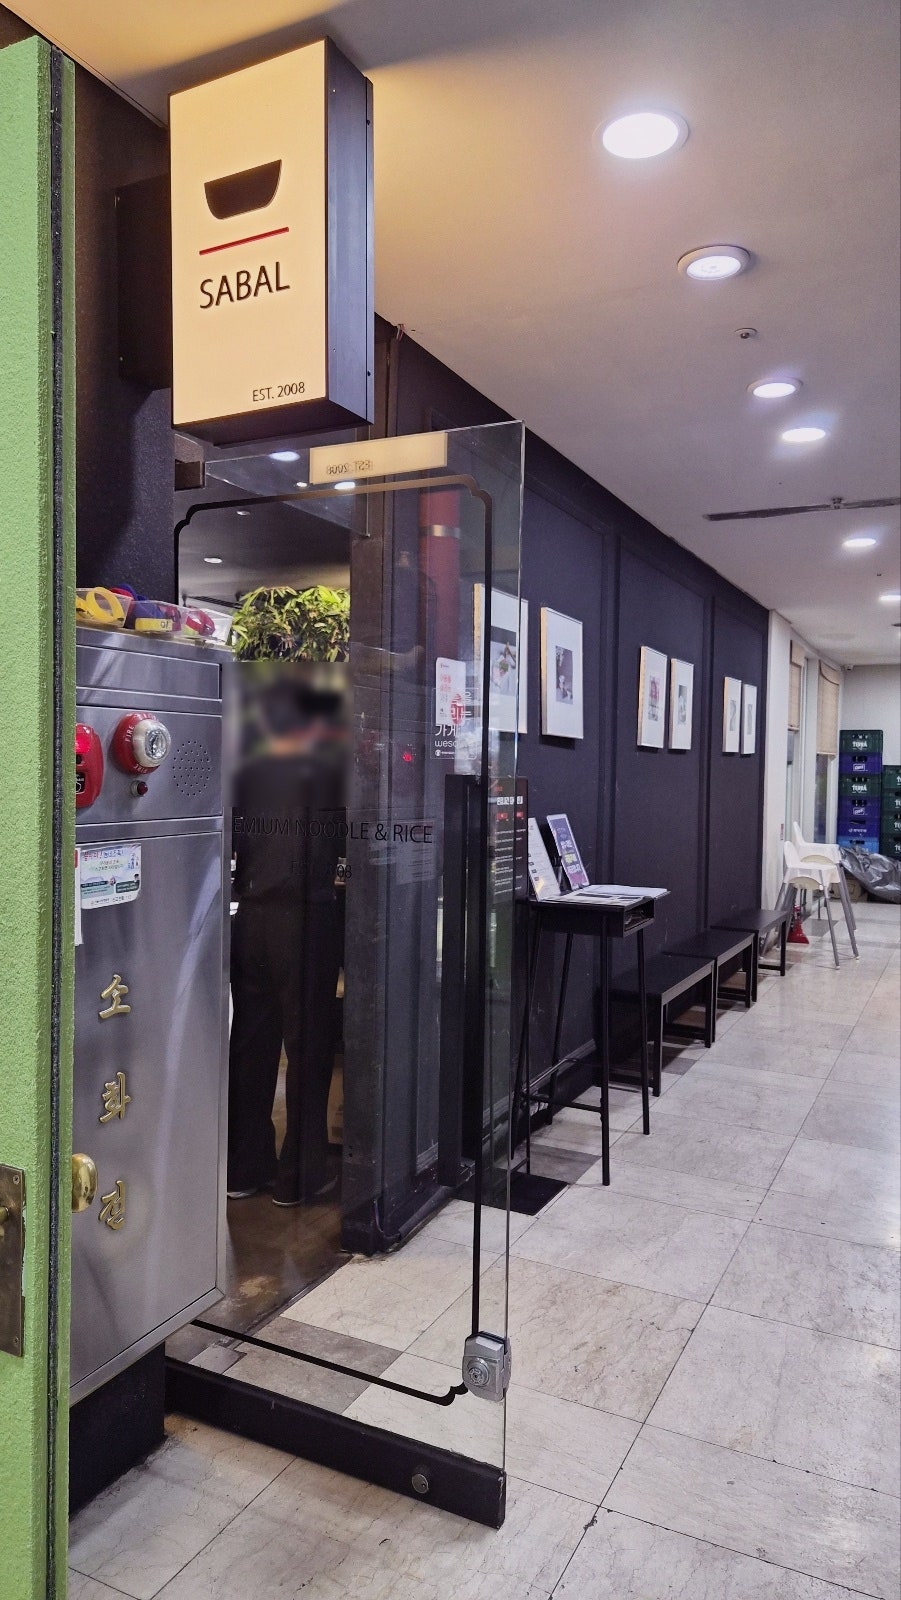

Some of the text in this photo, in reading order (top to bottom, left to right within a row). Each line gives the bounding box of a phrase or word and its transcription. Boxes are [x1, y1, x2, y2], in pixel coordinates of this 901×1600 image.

[199, 261, 291, 309] SABAL
[252, 381, 306, 402] EST. 2008
[125, 726, 135, 742] FIRE
[295, 819, 370, 841] NOODLE
[374, 823, 388, 841] &
[392, 824, 433, 844] RICE
